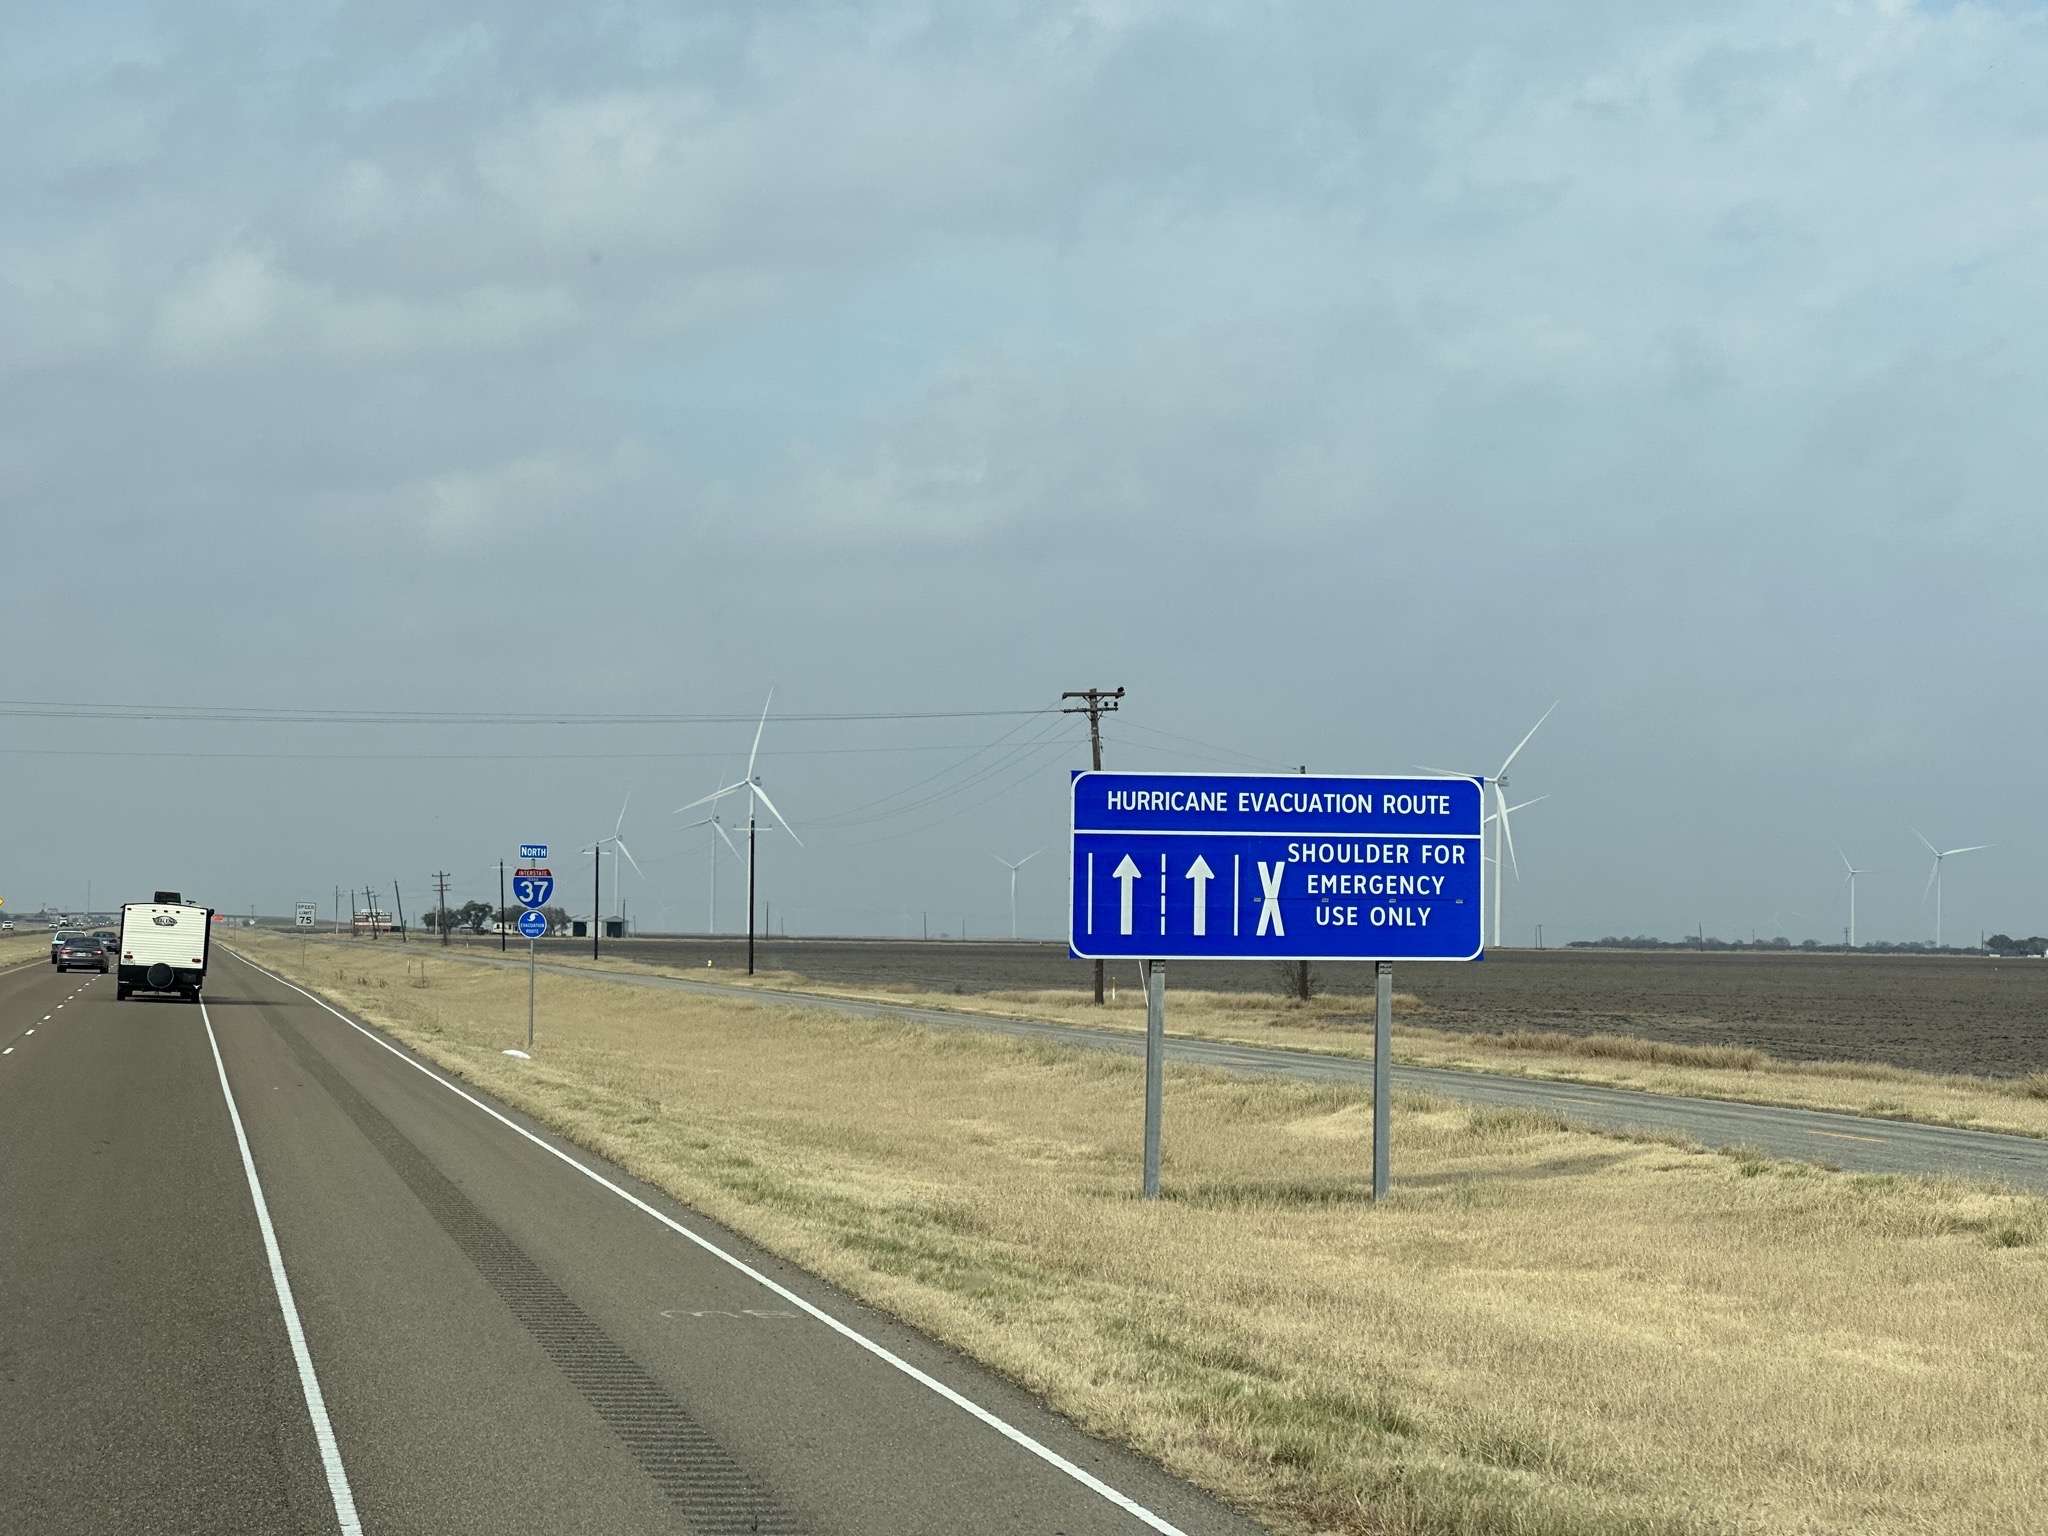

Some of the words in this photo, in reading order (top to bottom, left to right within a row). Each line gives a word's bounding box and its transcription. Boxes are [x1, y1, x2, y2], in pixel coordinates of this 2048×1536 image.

[1107, 790, 1228, 812] HURRICANE
[1238, 792, 1372, 814] EVACUATION
[1383, 794, 1450, 815] ROUTE
[521, 846, 546, 857] NORTH
[1287, 842, 1409, 864] SHOULDER
[1422, 844, 1465, 865] FOR
[520, 882, 548, 902] 37
[1307, 874, 1445, 895] EMERGENCY
[1316, 906, 1358, 926] USE
[1370, 906, 1431, 927] ONLY
